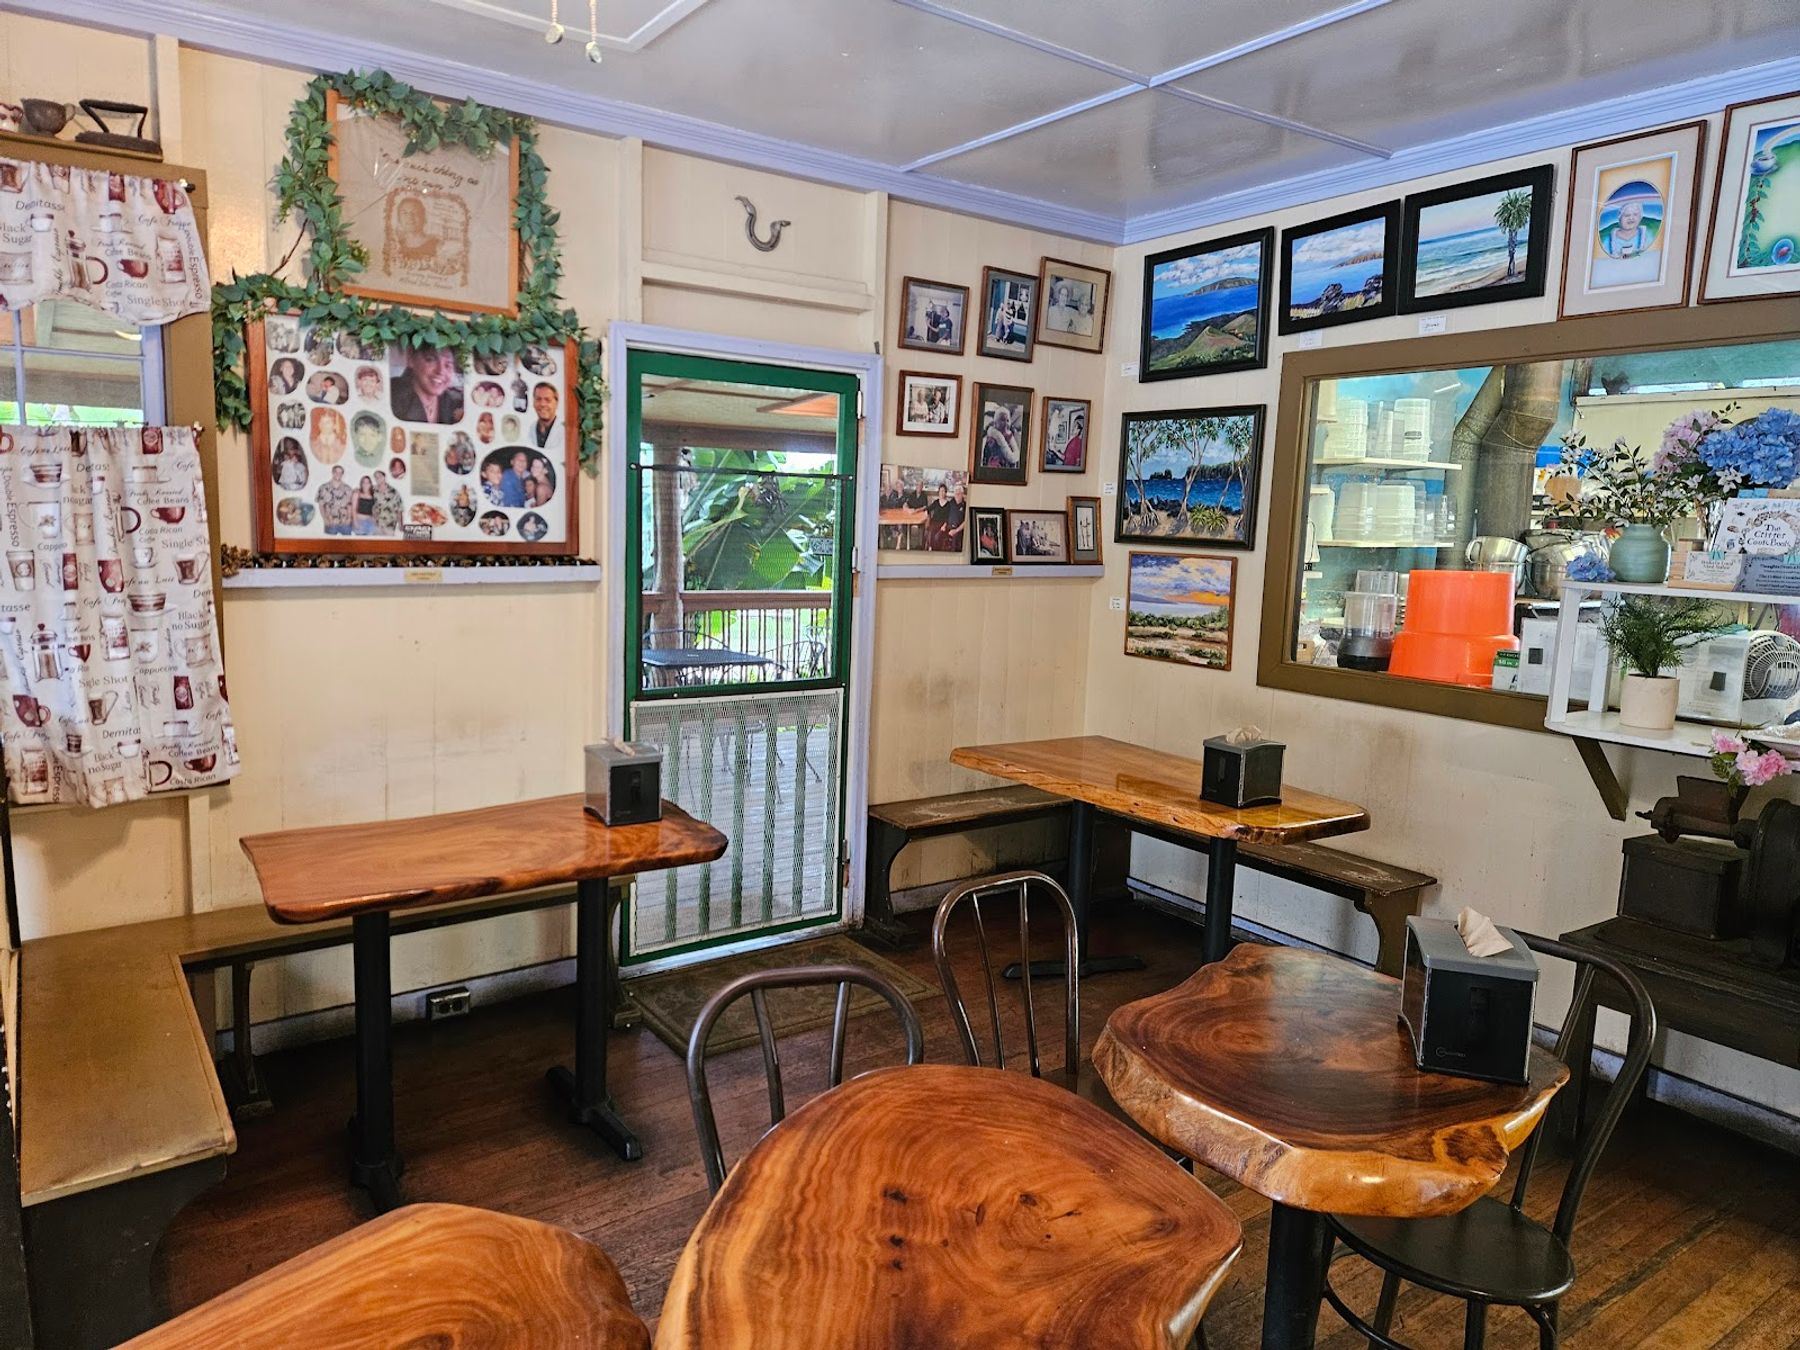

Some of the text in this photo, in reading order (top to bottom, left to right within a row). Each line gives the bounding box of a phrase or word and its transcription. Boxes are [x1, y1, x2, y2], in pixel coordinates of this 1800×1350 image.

[0, 223, 26, 233] lack
[3, 232, 33, 246] Sugar
[6, 502, 20, 548] Espresso
[1764, 524, 1781, 532] The
[1753, 530, 1787, 540] Critter
